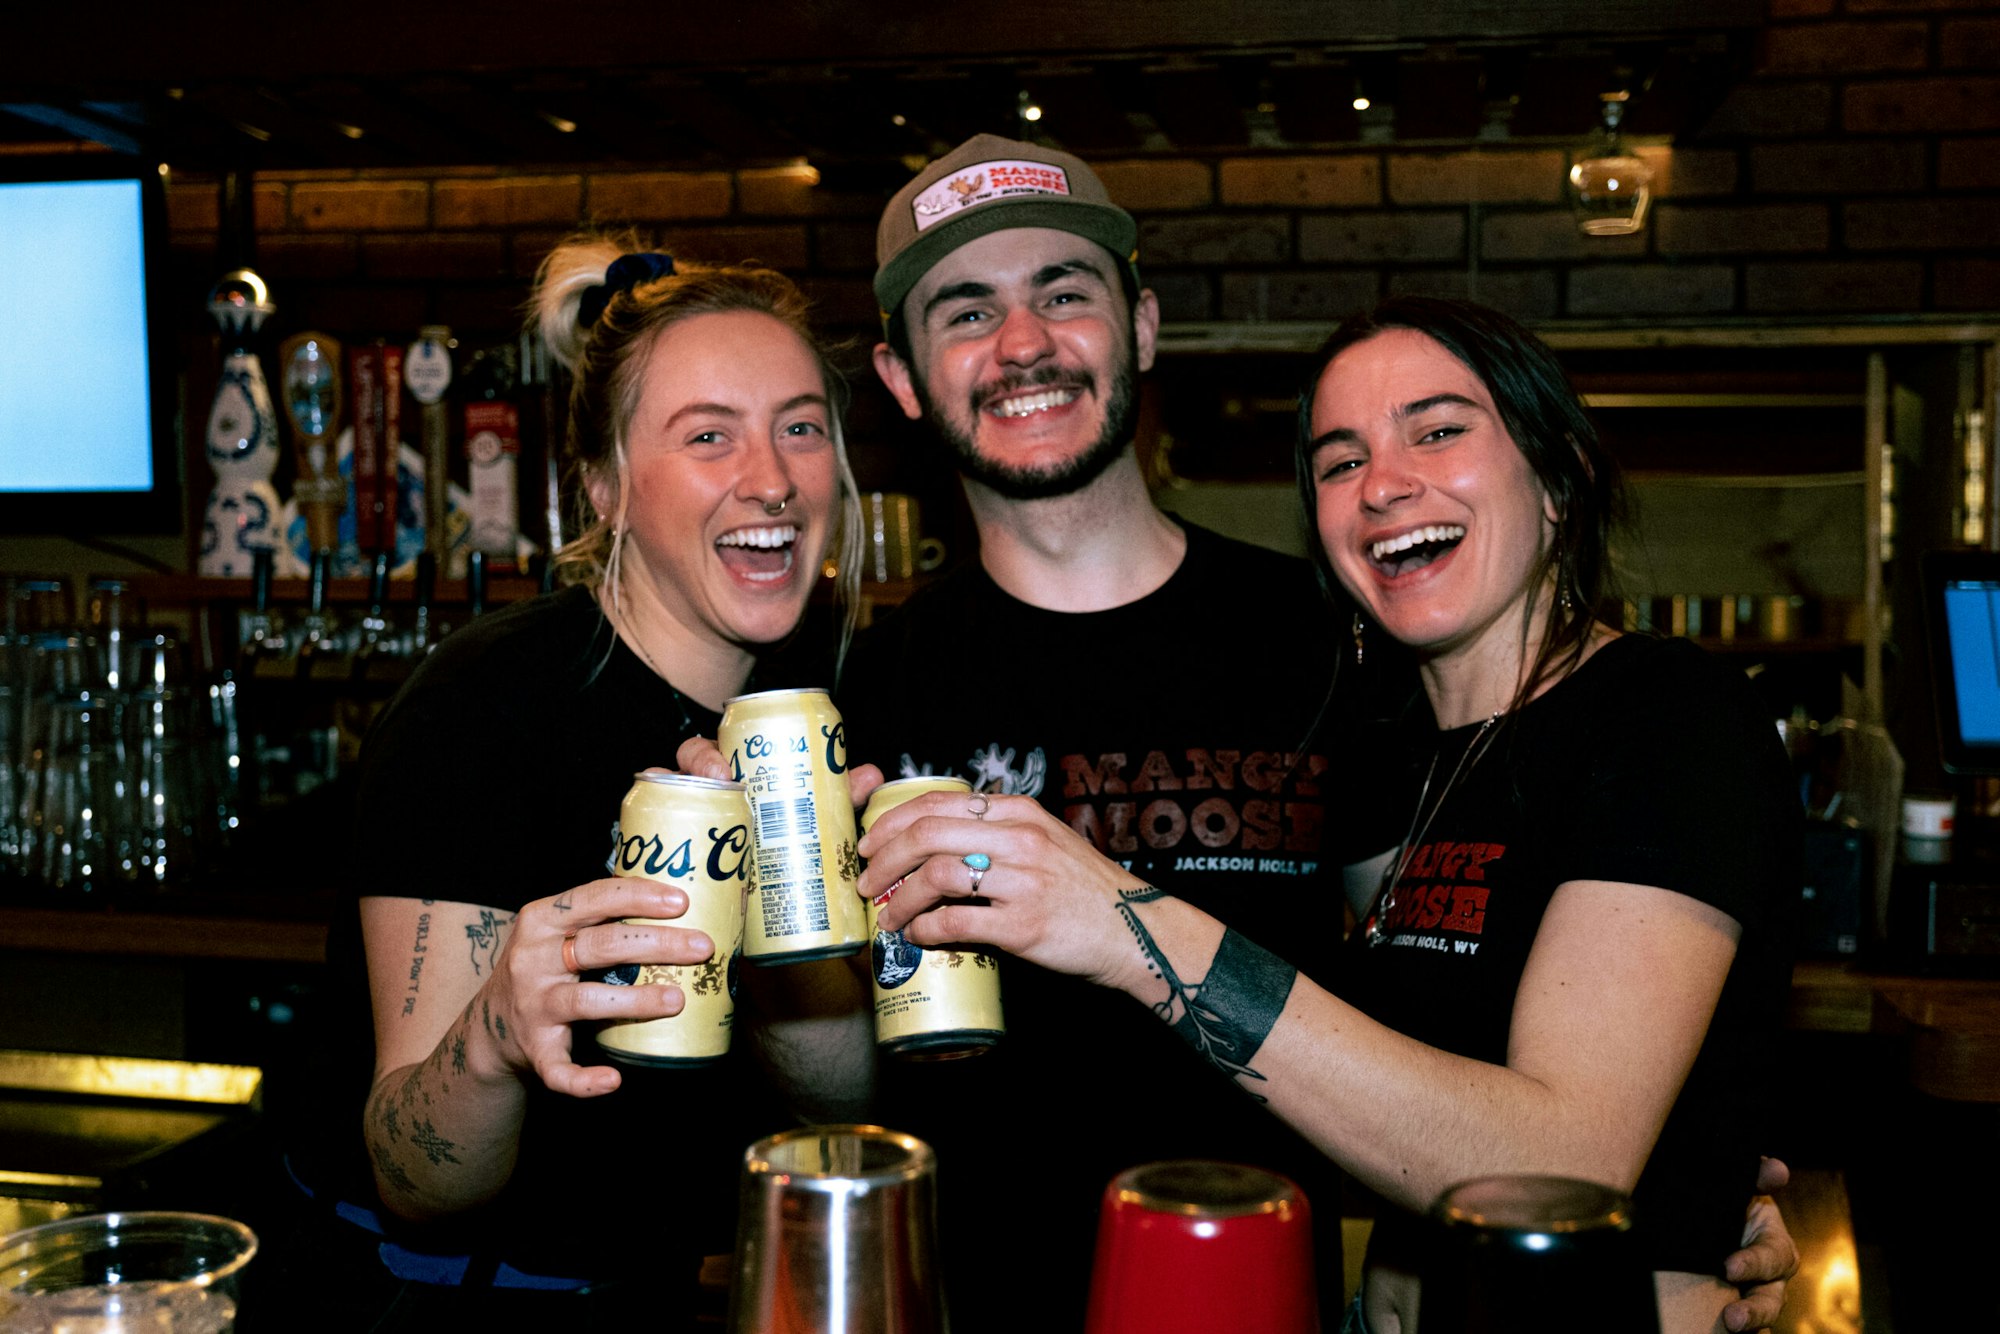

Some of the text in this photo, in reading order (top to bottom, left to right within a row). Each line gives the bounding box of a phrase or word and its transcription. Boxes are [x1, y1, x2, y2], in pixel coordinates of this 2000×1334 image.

[988, 167, 1062, 180] MANGY
[991, 176, 1067, 193] MOOSE
[1060, 748, 1329, 798] MANGY
[1064, 797, 1326, 853] MOOSE
[1173, 857, 1254, 872] JACKSON
[414, 913, 431, 953] GIRLS
[1416, 935, 1449, 952] HOLE,
[1454, 940, 1480, 955] WY
[884, 1000, 908, 1010] MOUNTAIN
